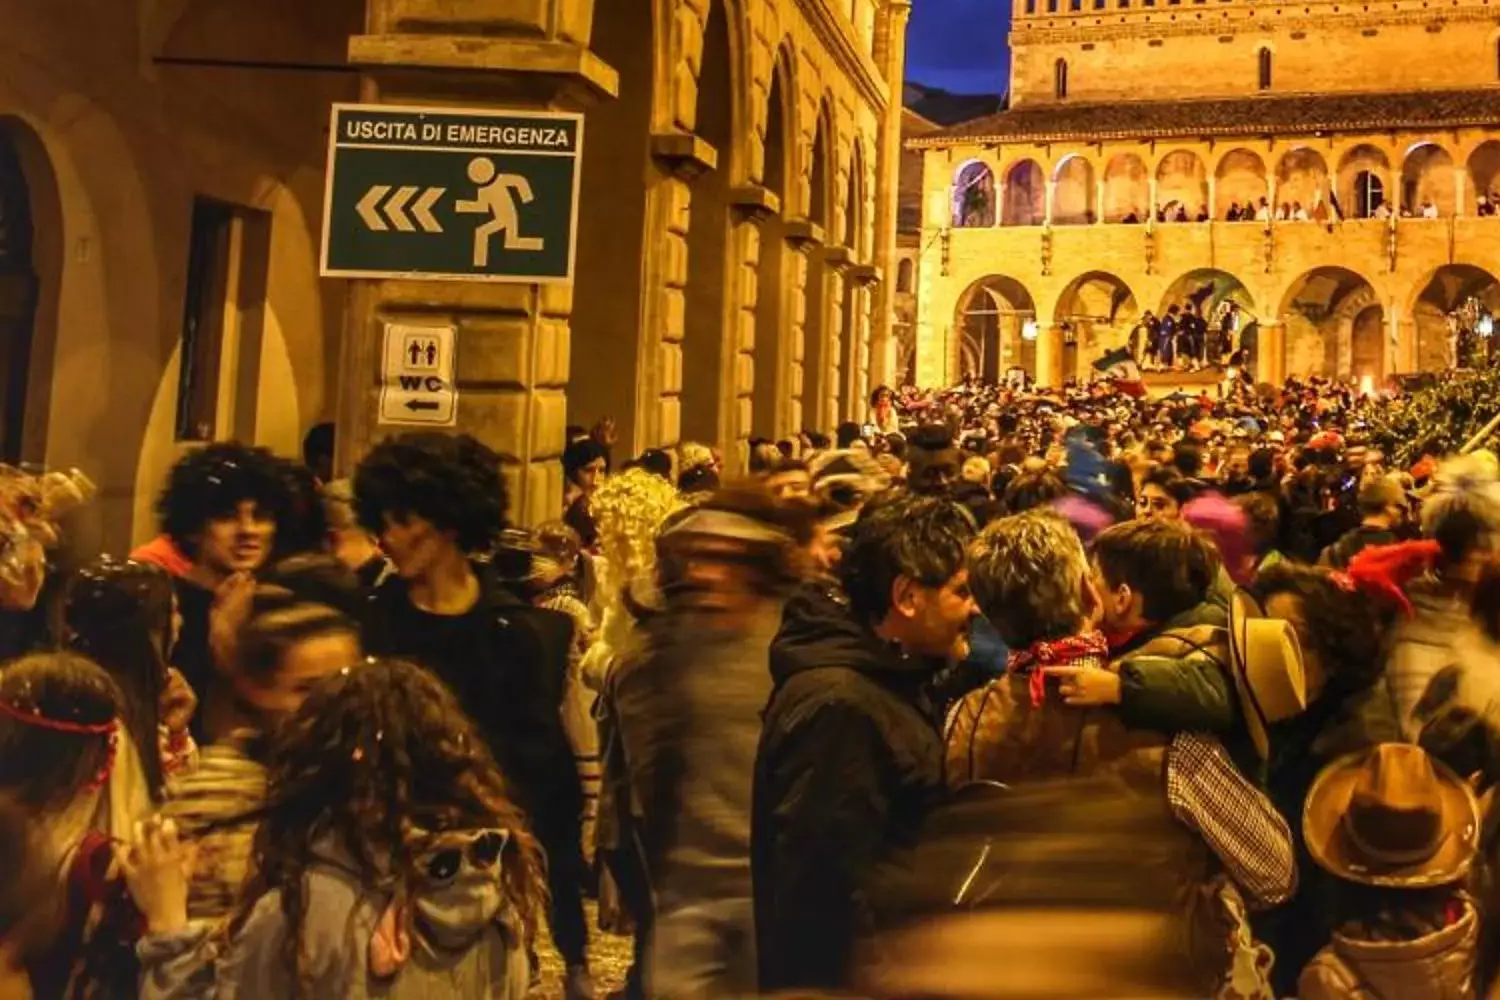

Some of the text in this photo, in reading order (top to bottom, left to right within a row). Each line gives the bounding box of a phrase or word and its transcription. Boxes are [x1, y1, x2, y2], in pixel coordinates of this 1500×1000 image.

[346, 120, 569, 147] USCITA DI EMERGENZA
[400, 375, 442, 392] WC
